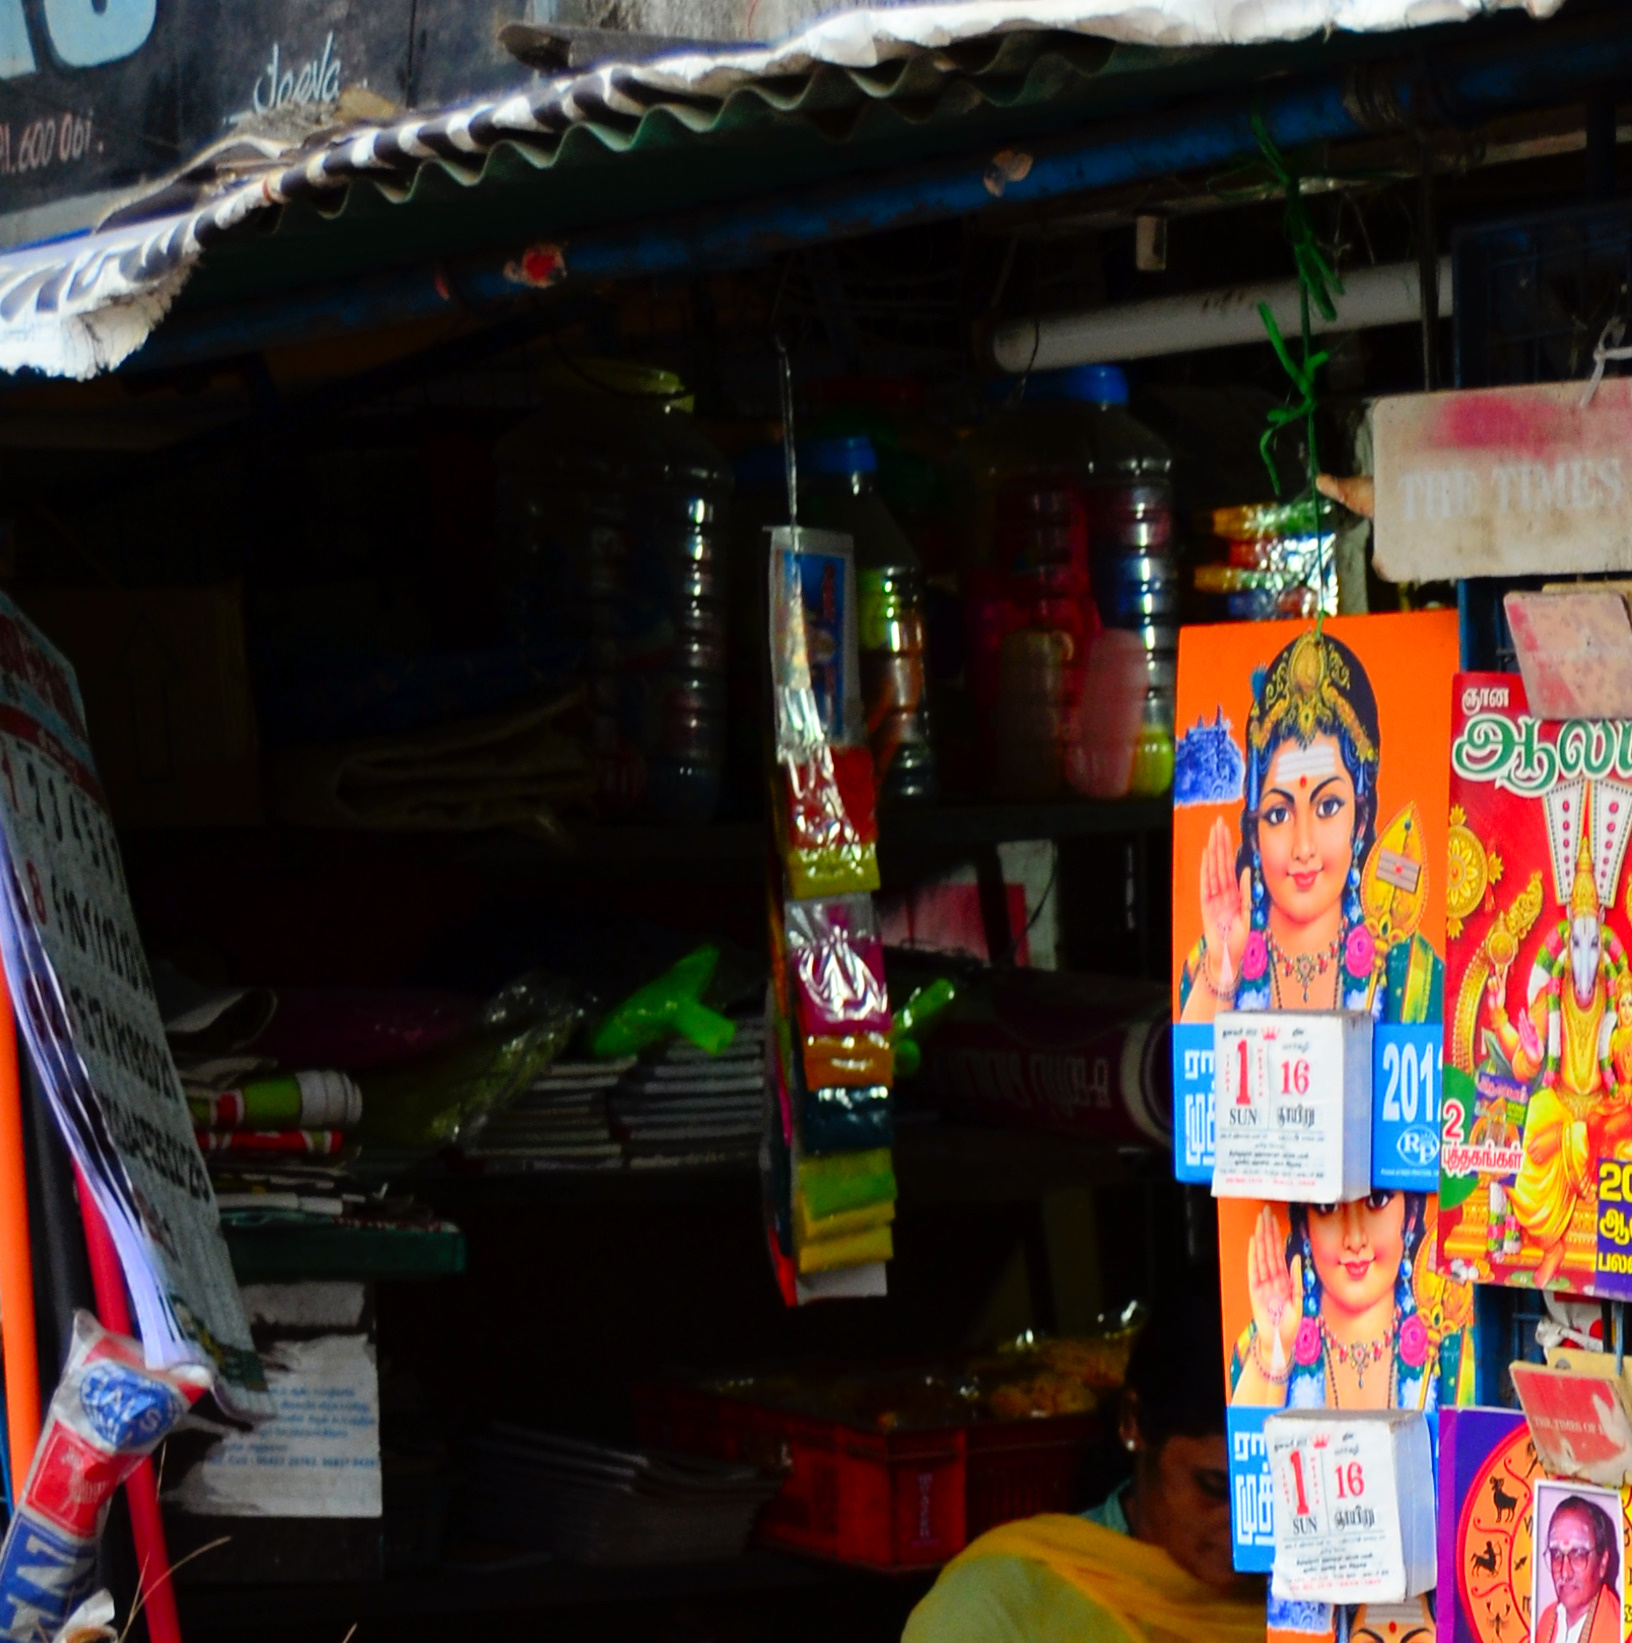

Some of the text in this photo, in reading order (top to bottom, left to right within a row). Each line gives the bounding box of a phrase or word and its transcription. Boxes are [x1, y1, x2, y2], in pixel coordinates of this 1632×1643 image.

[1402, 468, 1477, 521] THE
[1491, 456, 1620, 508] TIMES
[1461, 685, 1509, 711] ஞான
[1234, 1040, 1251, 1105] 1
[1281, 1061, 1310, 1096] 16
[1229, 1108, 1258, 1126] SUN
[1443, 1102, 1466, 1141] 2
[1442, 1143, 1525, 1181] புத்தகங்கள்
[1291, 1450, 1310, 1516] 1
[1335, 1462, 1365, 1498] 16
[1292, 1516, 1319, 1535] SUN
